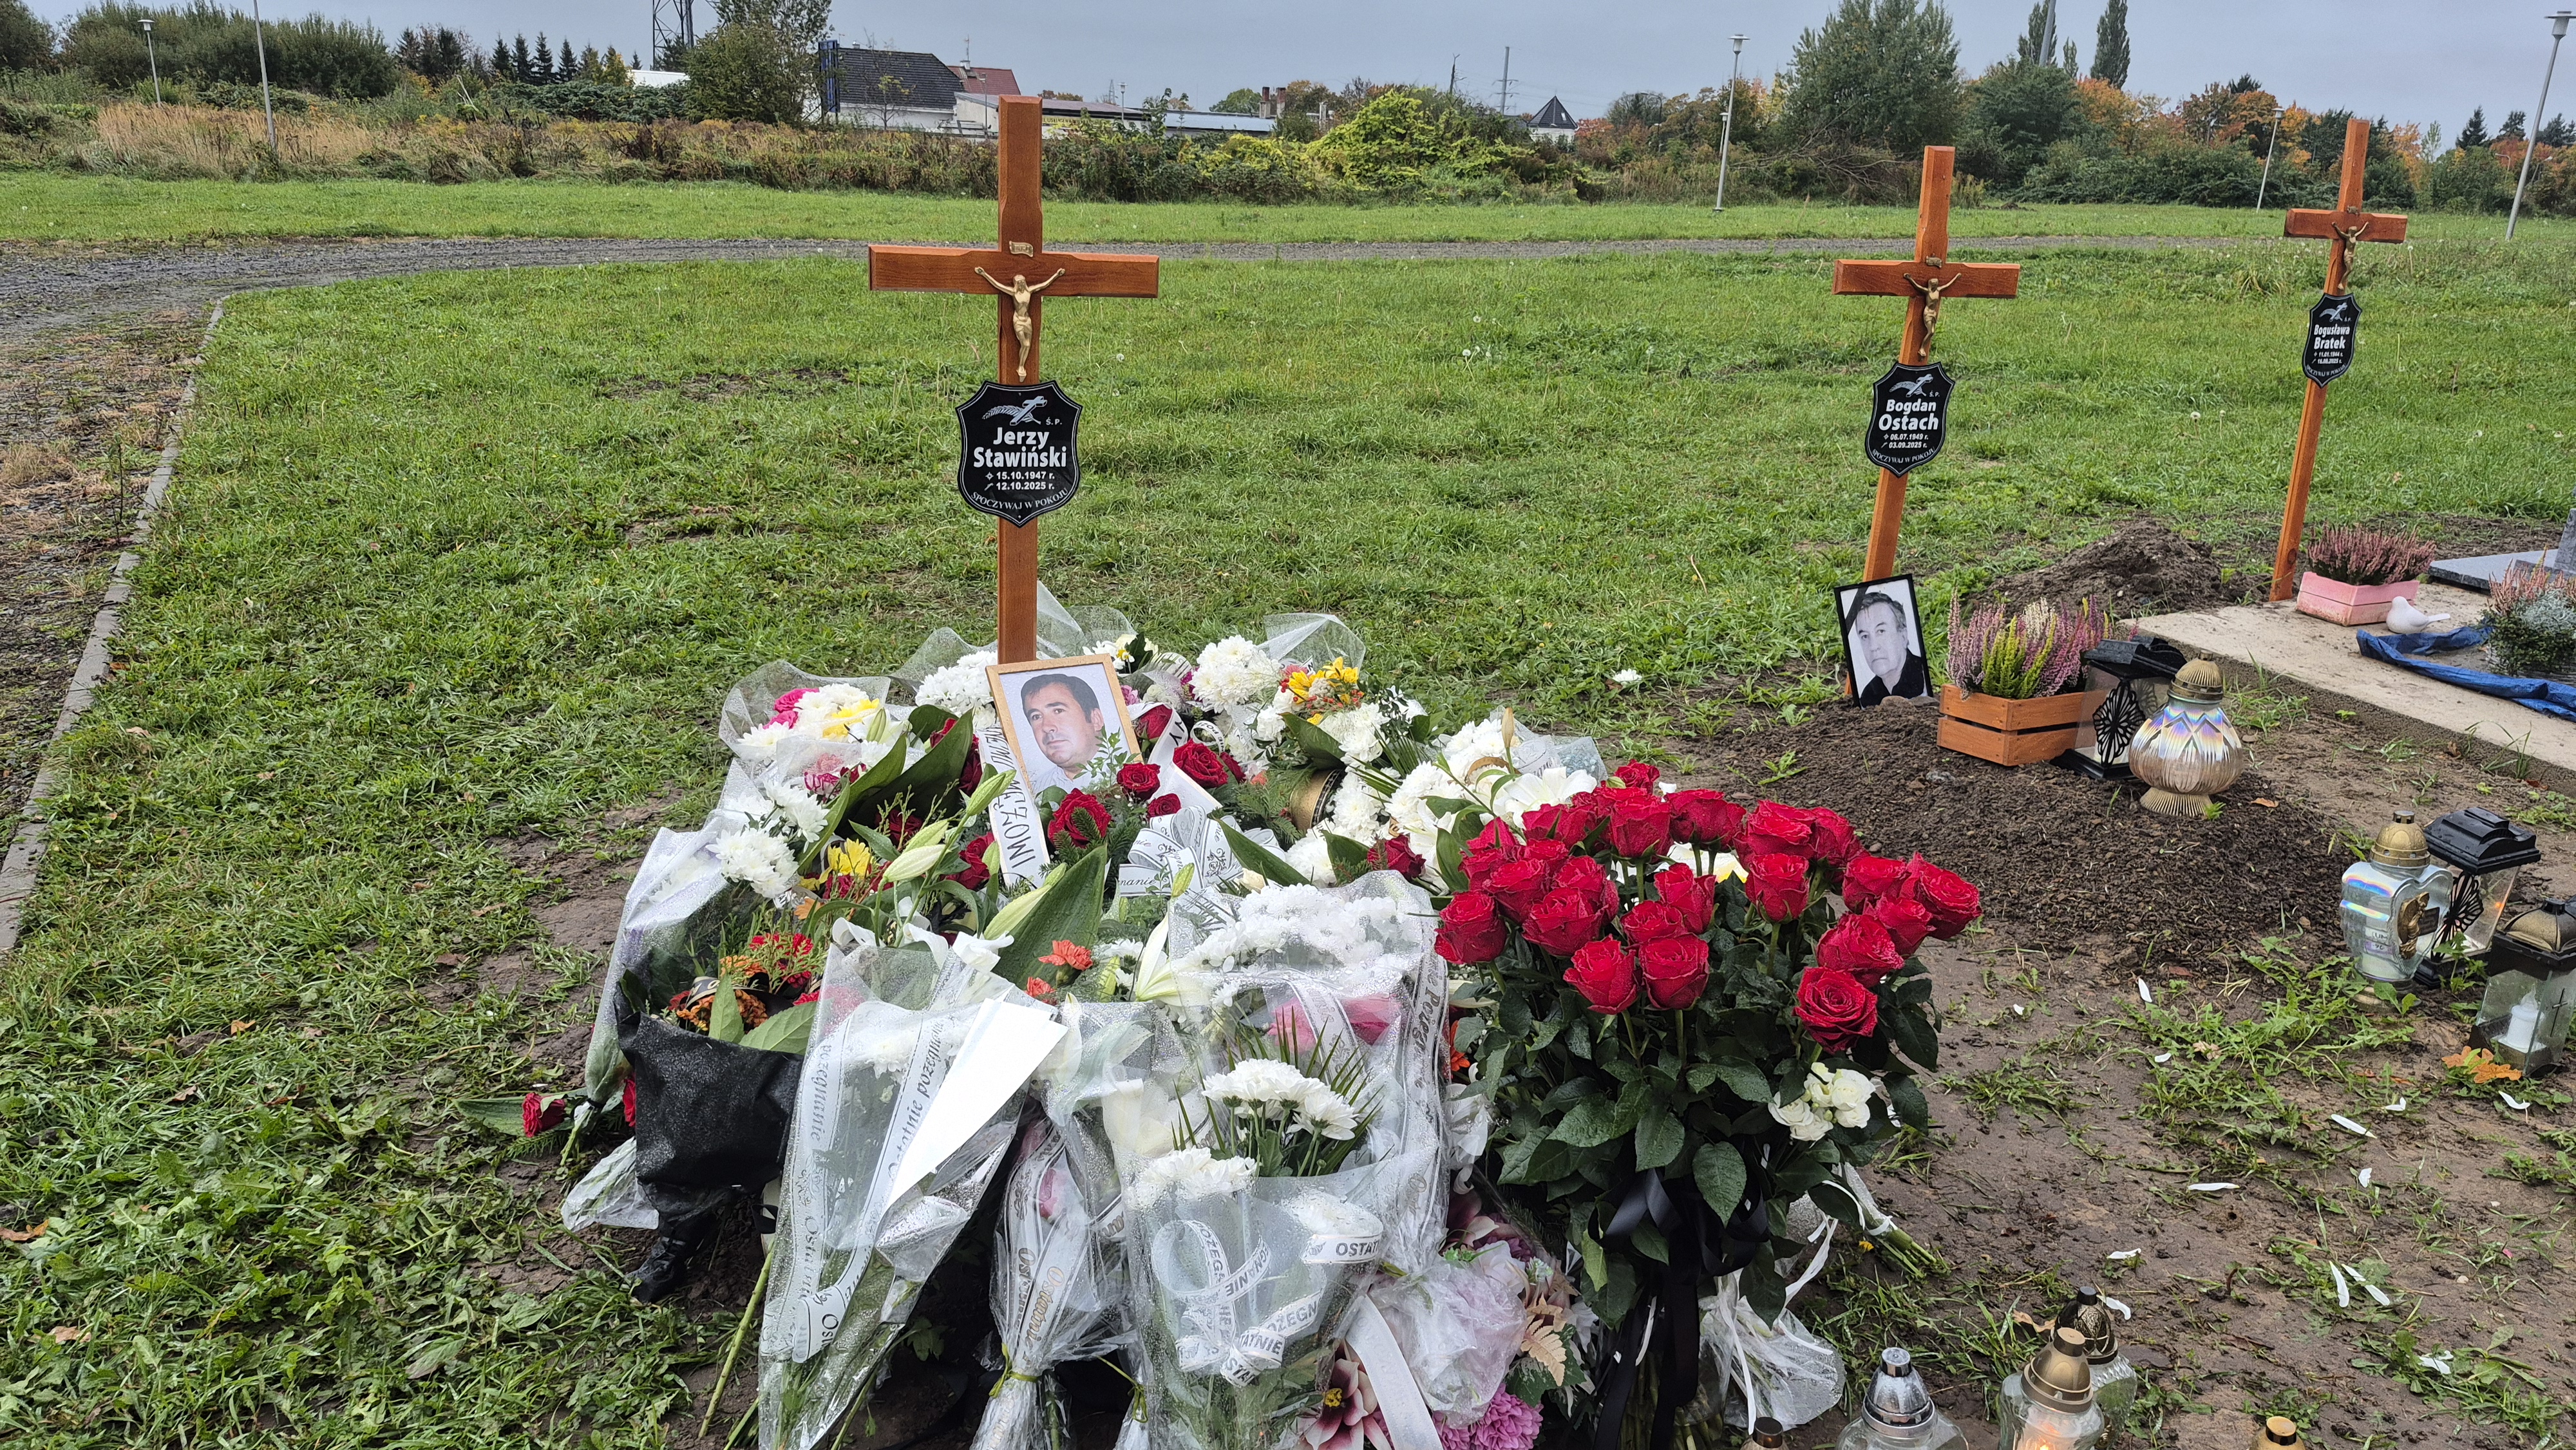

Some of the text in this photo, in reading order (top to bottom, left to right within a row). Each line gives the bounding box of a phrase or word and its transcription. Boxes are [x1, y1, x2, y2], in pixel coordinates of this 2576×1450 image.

[2313, 323, 2351, 338] Bogusława
[2313, 335, 2346, 350] Bratek
[1886, 398, 1937, 415] Bogdan
[1879, 413, 1939, 431] Ostach
[993, 427, 1050, 450] Jerzy
[973, 446, 1067, 468] Stawiński
[1871, 449, 1904, 464] SPOCZYWAJ
[996, 471, 1046, 480] 15.10.1947
[996, 482, 1046, 490] 12.10.2025
[971, 491, 1023, 510] SPOCZYWAJ
[1035, 487, 1068, 507] POKOJU
[1025, 1266, 1065, 1350] Ostatnie
